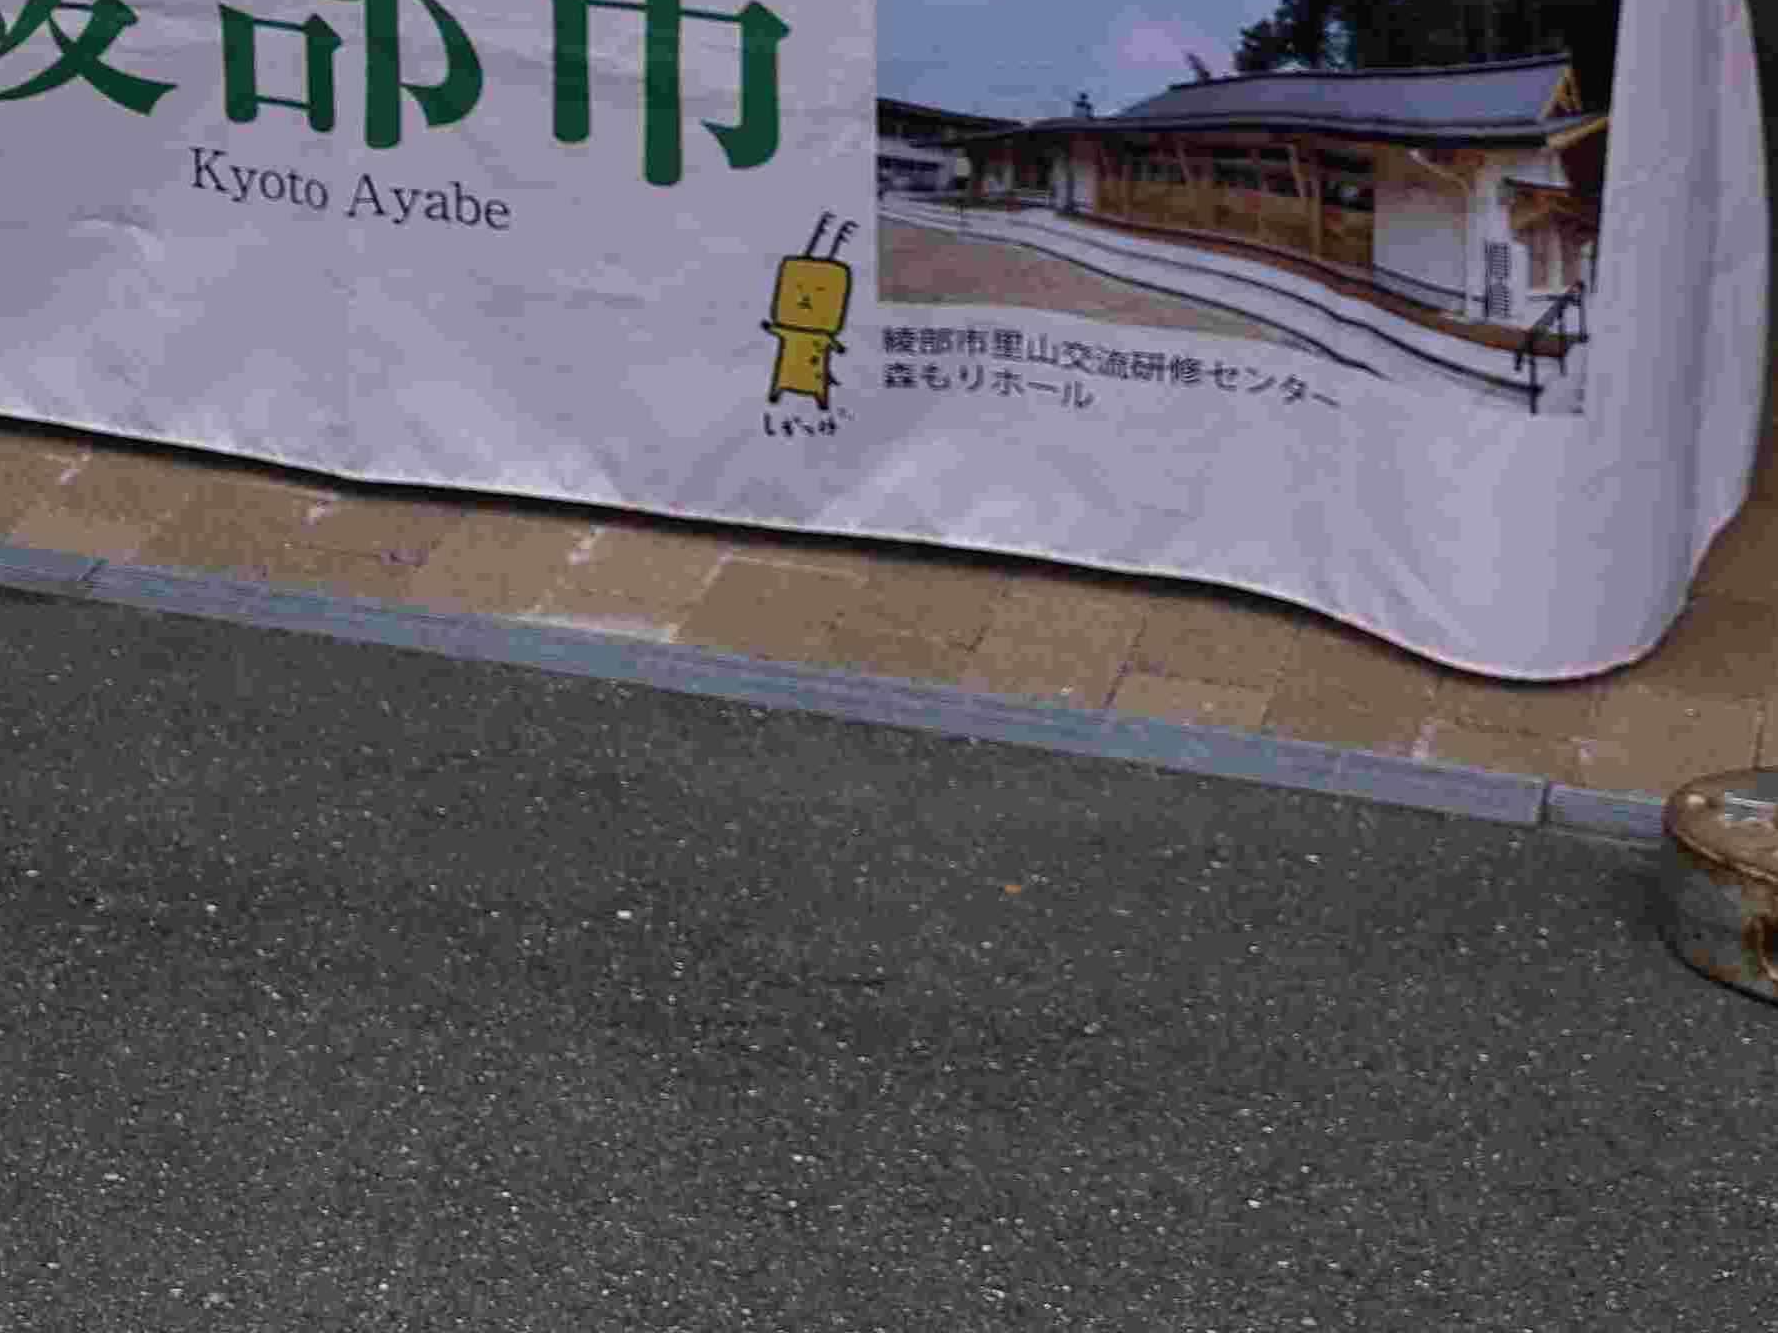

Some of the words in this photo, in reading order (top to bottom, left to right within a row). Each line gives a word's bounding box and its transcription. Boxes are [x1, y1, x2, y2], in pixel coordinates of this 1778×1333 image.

[188, 145, 329, 212] Kyoto
[345, 172, 511, 230] Ayabe
[882, 326, 1341, 408] 綾部市里山交流研修センター
[883, 362, 1096, 409] 森もりホール
